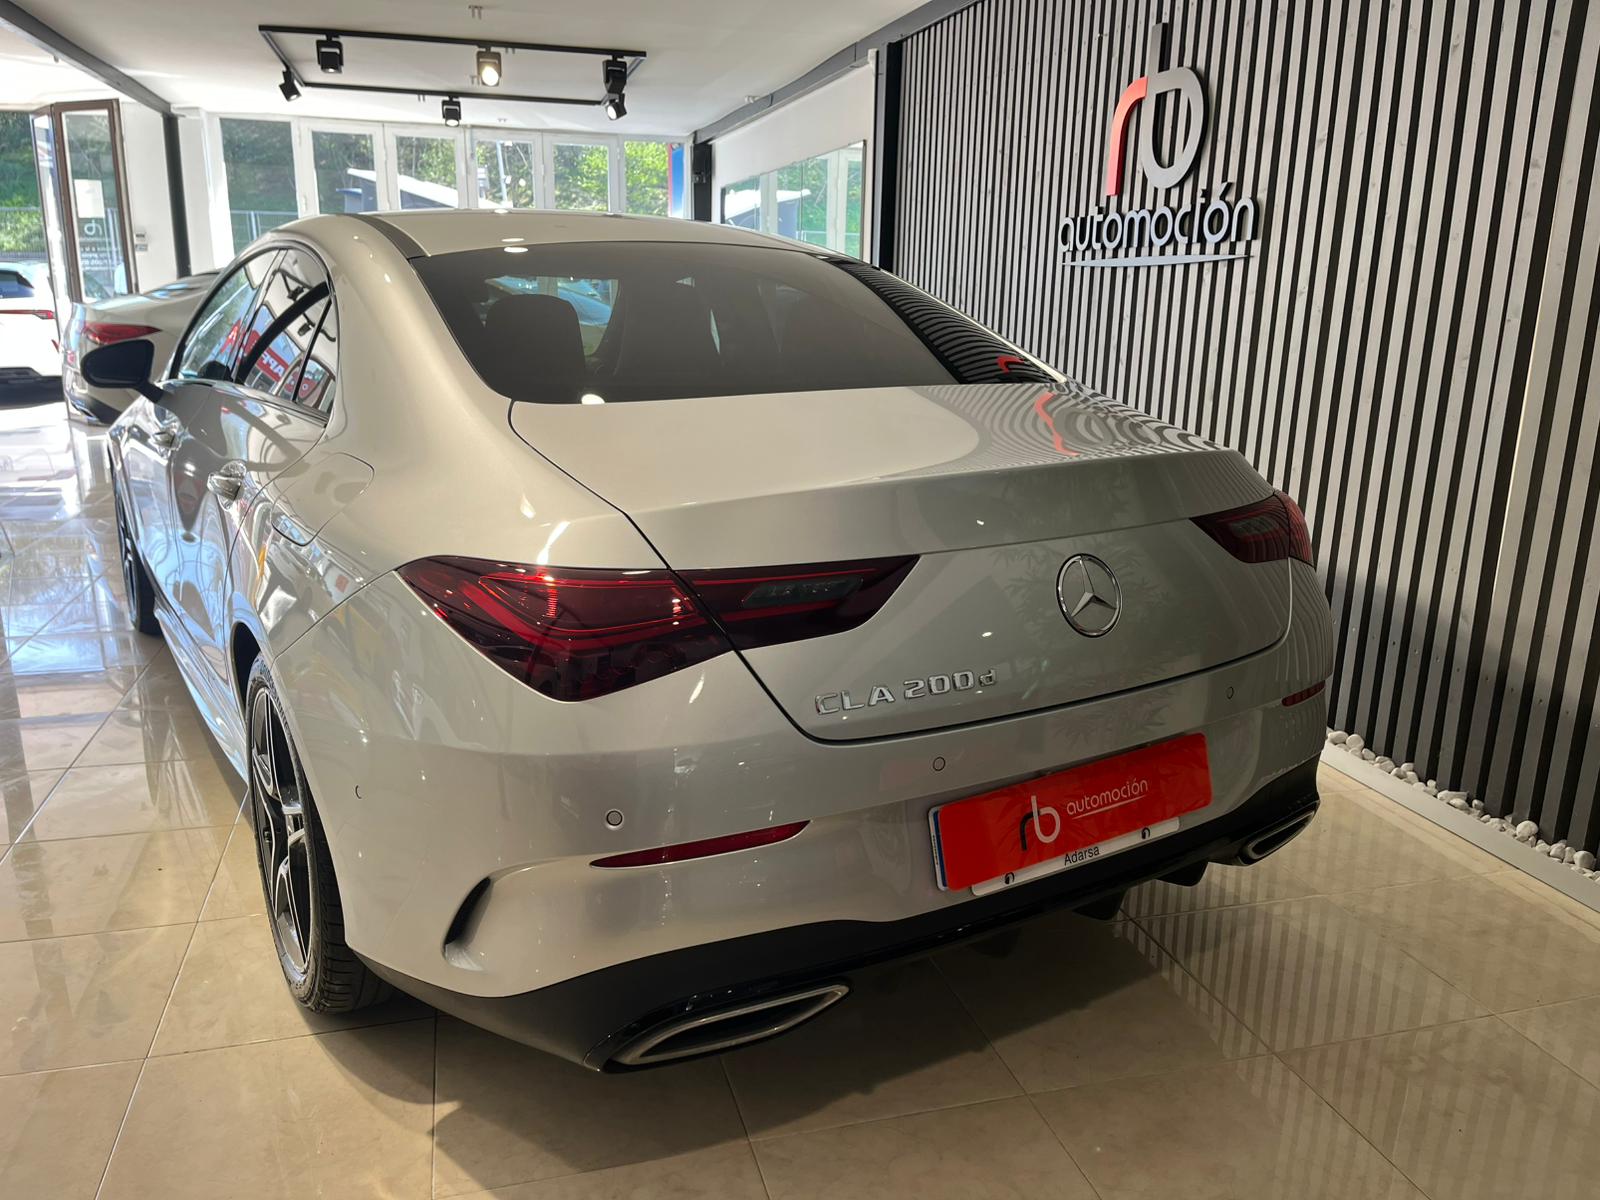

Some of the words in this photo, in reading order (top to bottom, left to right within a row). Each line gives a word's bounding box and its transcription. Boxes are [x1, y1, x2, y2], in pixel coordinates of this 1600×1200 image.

[1059, 182, 1256, 252] automoción
[815, 686, 896, 715] CLA
[1066, 778, 1149, 815] automoción
[1064, 846, 1101, 866] Adarsa
